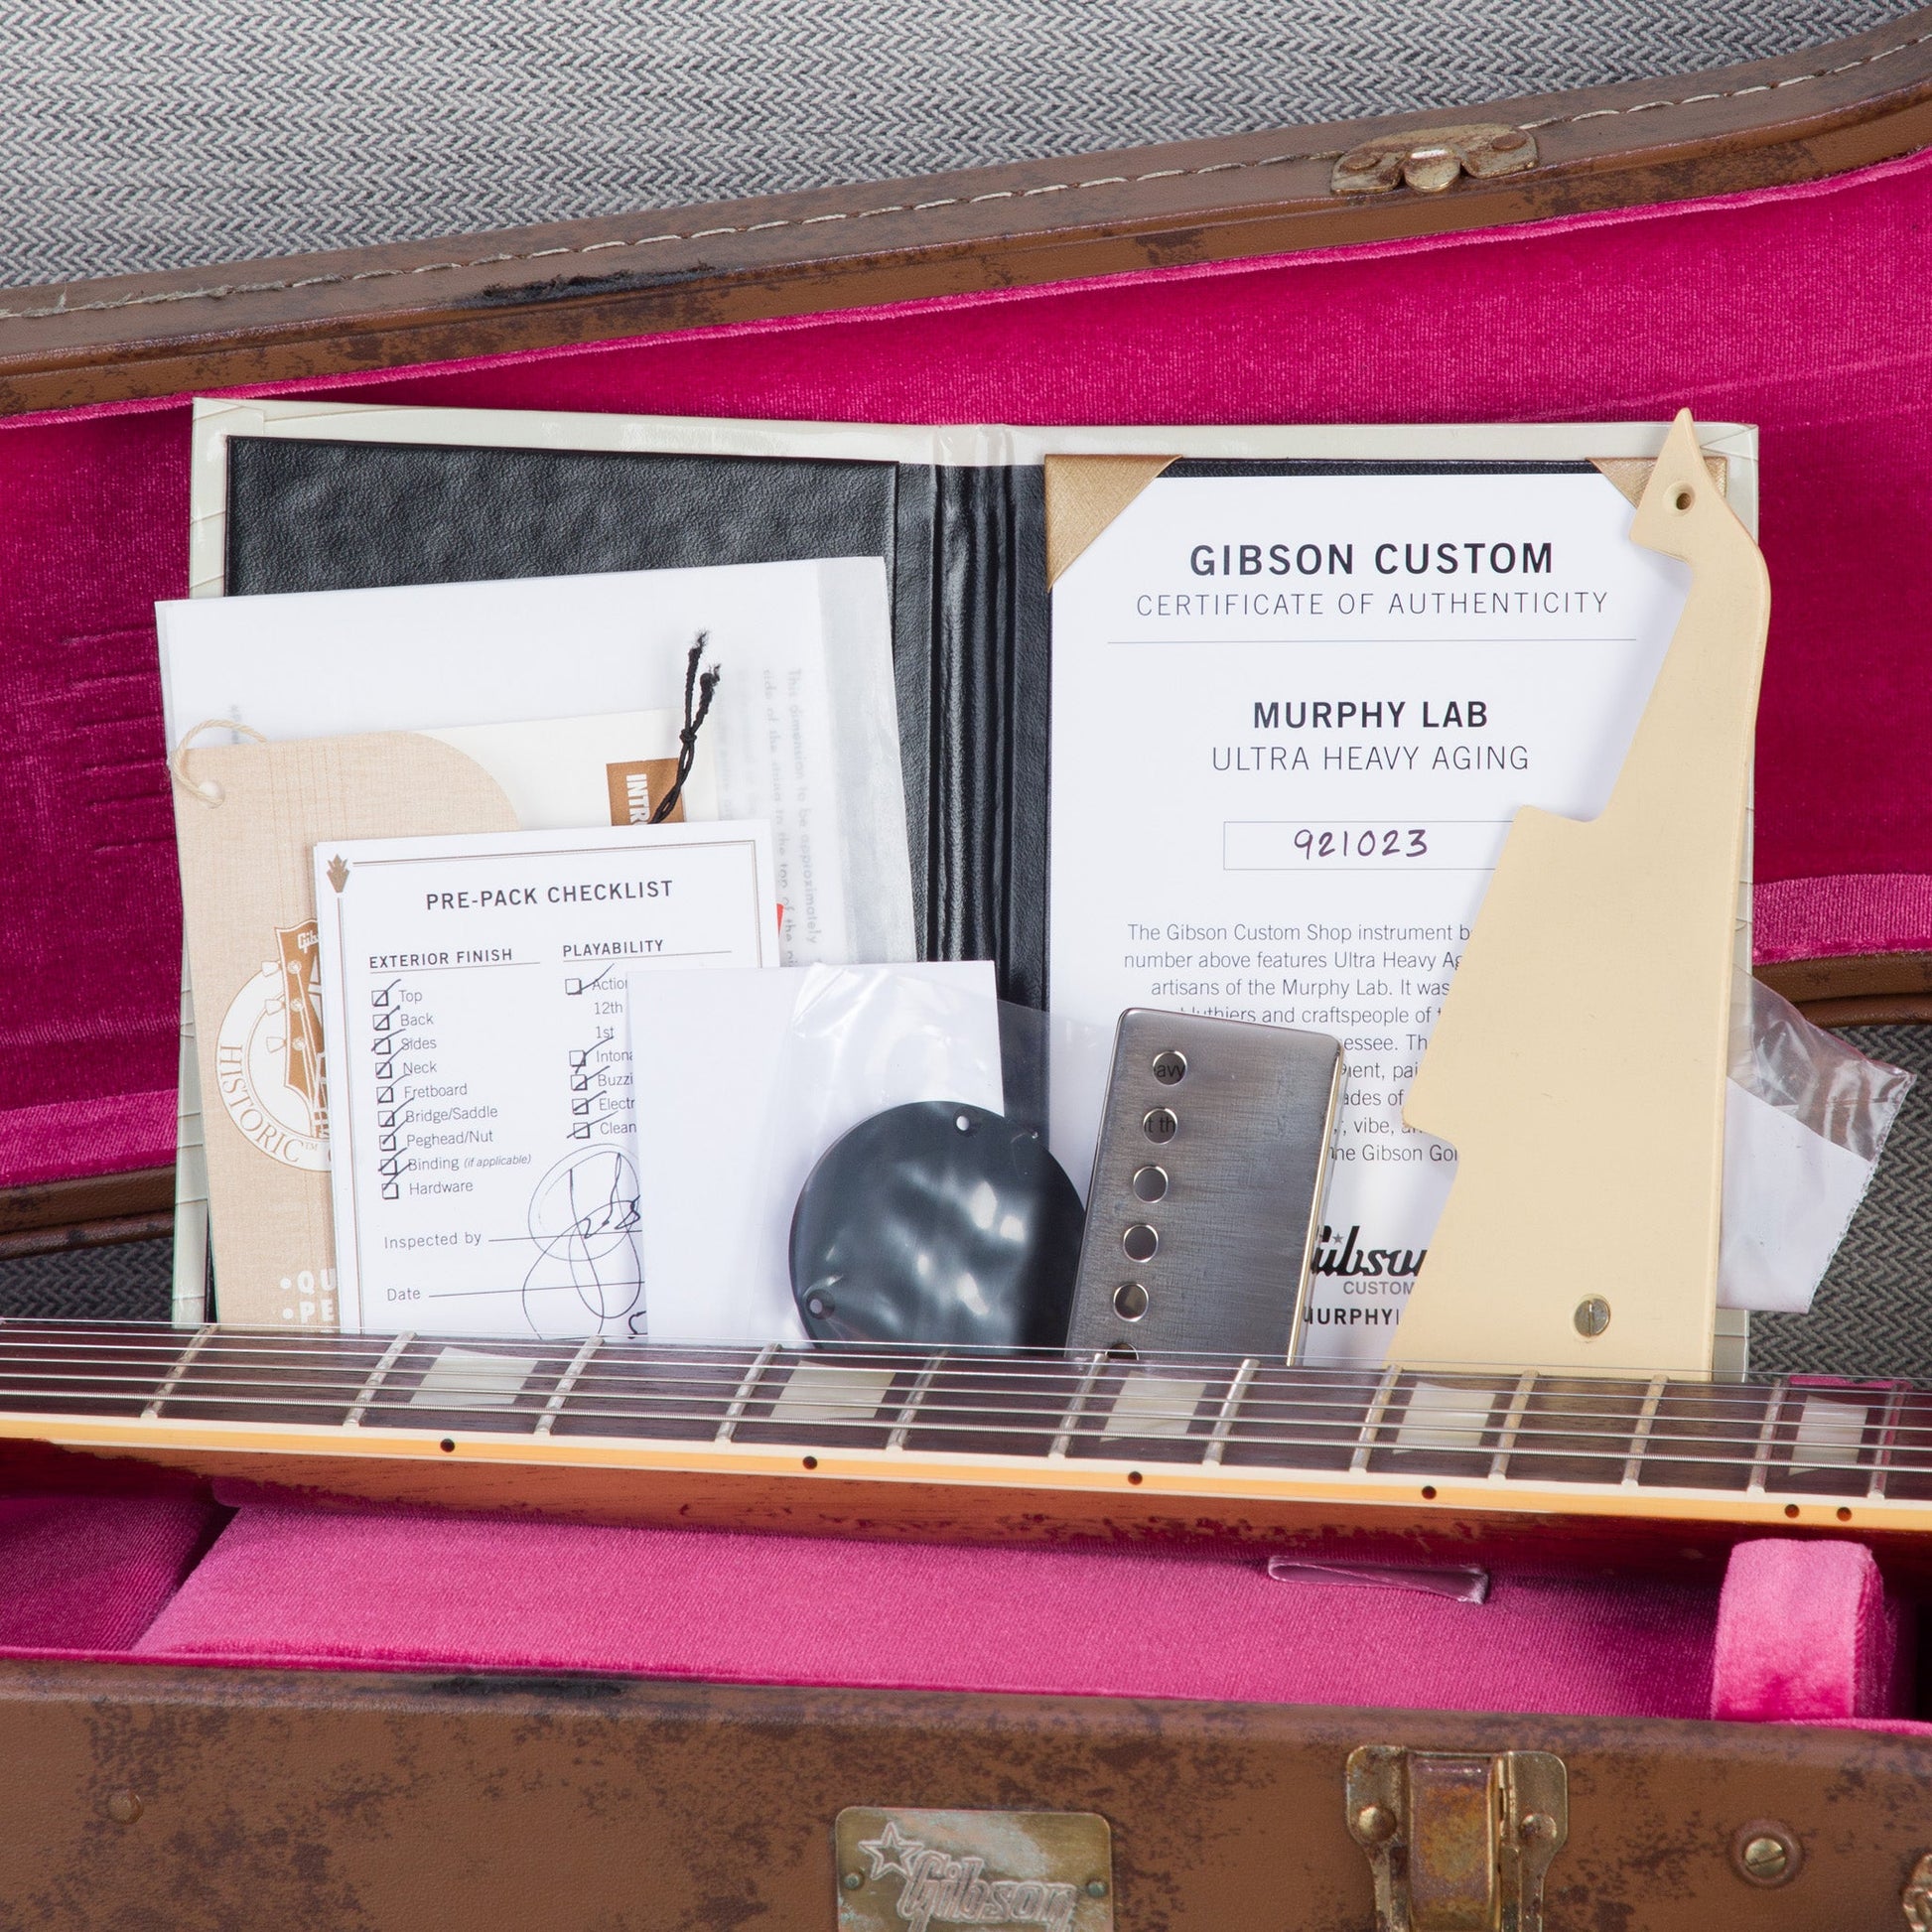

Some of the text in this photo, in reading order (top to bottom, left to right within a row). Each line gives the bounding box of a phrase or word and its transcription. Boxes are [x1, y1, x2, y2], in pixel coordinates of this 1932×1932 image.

[1190, 542, 1552, 576] GIBSON CUSTOM
[1137, 592, 1607, 616] CERTIFICATE OF AUTHENTICITY
[1254, 701, 1488, 729] MURPHY LAB
[1212, 746, 1529, 771] ULTRA HEAVY AGING
[1294, 829, 1428, 860] 921023
[426, 880, 673, 910] PRE-PACK CHECKLIST
[798, 833, 822, 944] approximately
[784, 917, 798, 943] the
[1128, 923, 1161, 940] The
[1167, 923, 1227, 940] Gibson
[1234, 923, 1301, 940] Custom
[1307, 923, 1352, 944] Shop
[1358, 923, 1452, 940] instrument
[563, 939, 663, 957] PLAYABILITY
[369, 948, 512, 969] EXTERIOR FINISH
[1124, 951, 1192, 968] number
[1198, 951, 1251, 968] above
[1257, 951, 1327, 968] features
[1334, 951, 1375, 968] Ultra
[1383, 951, 1436, 972] Heavy
[398, 990, 423, 1005] Top
[1151, 978, 1449, 999] artisans of the Murphy Lab. It was
[594, 1001, 623, 1015] 12th
[1262, 1006, 1295, 1023] and
[1302, 1006, 1410, 1027] craftspeople
[1415, 1006, 1431, 1023] of
[400, 1013, 434, 1027] Back
[596, 1026, 615, 1038] 1st
[401, 1036, 437, 1051] Sides
[403, 1061, 438, 1074] Neck
[404, 1083, 468, 1099] Fretboard
[1388, 1088, 1404, 1105] of
[406, 1105, 497, 1124] Bridge/Saddle
[1353, 1117, 1394, 1135] vibe,
[406, 1130, 493, 1148] Peghead/Nut
[1362, 1144, 1423, 1161] Gibson
[408, 1158, 459, 1172] Binding
[477, 1154, 532, 1169] applicable)
[409, 1181, 474, 1195] Hardware
[383, 1230, 482, 1250] Inspected by
[387, 1288, 421, 1302] Date
[897, 1849, 1077, 1932] Gibson
